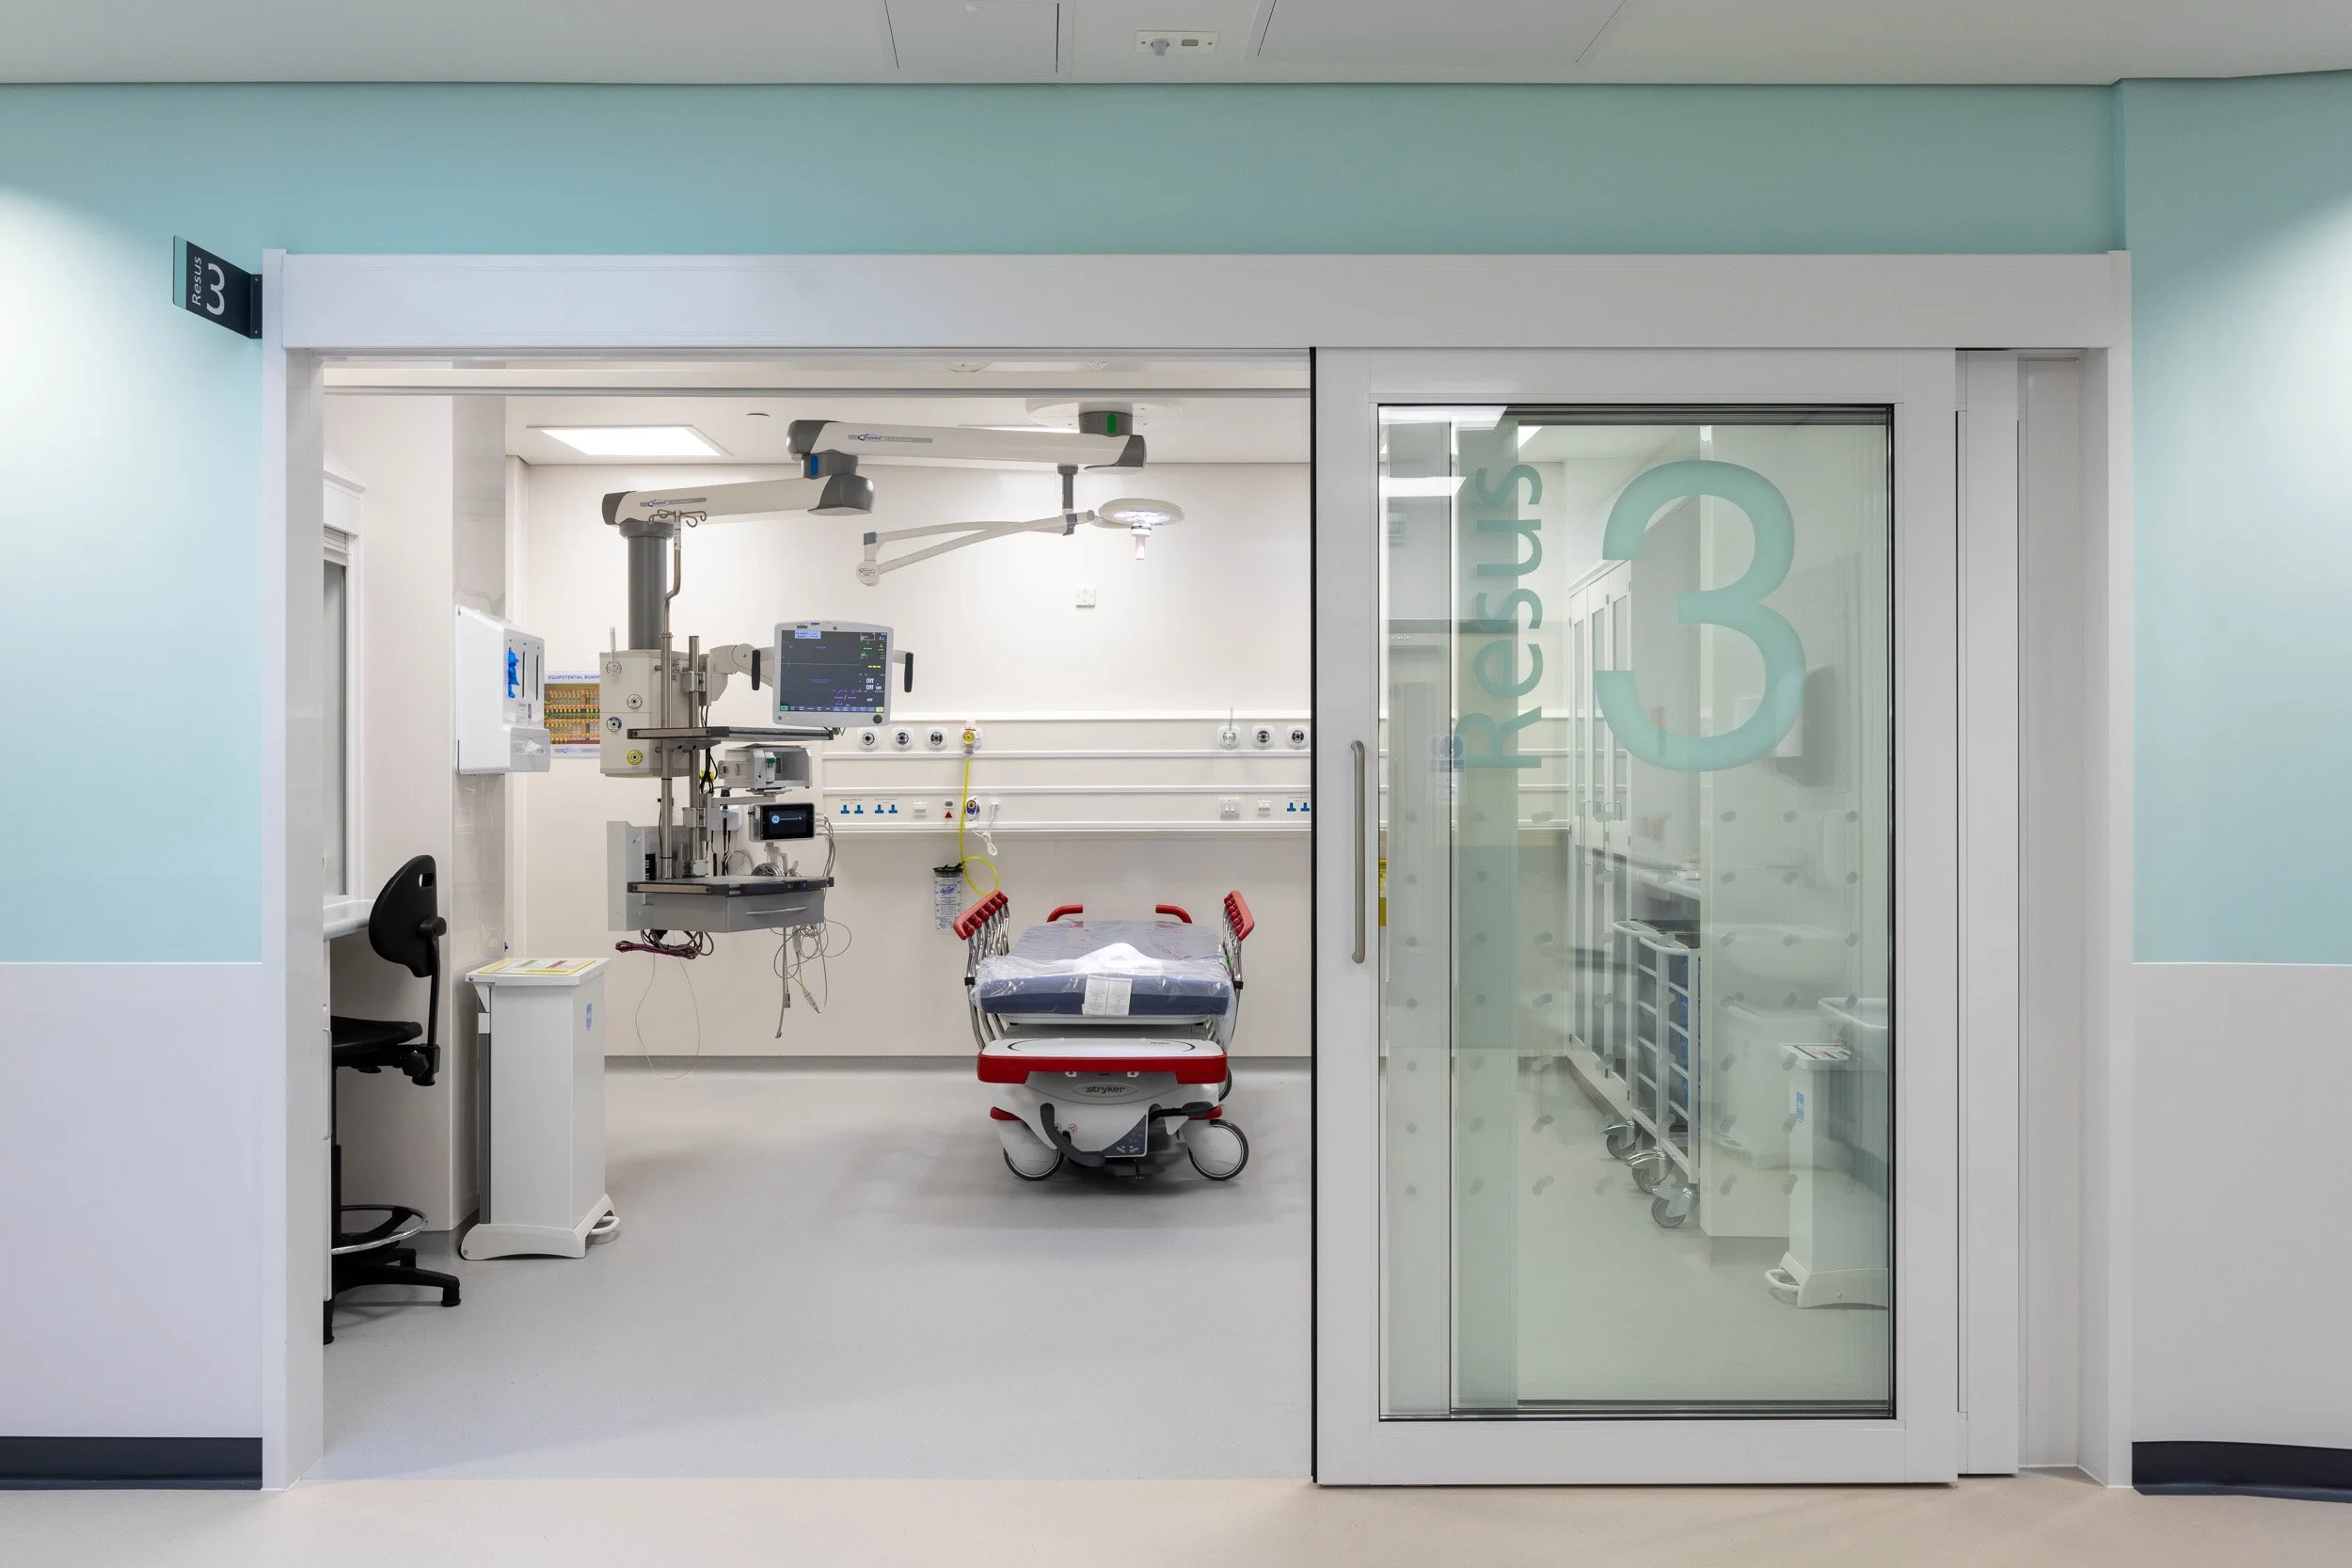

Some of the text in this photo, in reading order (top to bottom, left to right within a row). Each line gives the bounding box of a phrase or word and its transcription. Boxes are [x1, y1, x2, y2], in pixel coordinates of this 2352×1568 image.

[192, 256, 202, 306] Resus
[206, 262, 225, 315] 3
[1454, 464, 1543, 769] Resus
[1595, 459, 1807, 772] 3
[1086, 1085, 1126, 1094] stryker
